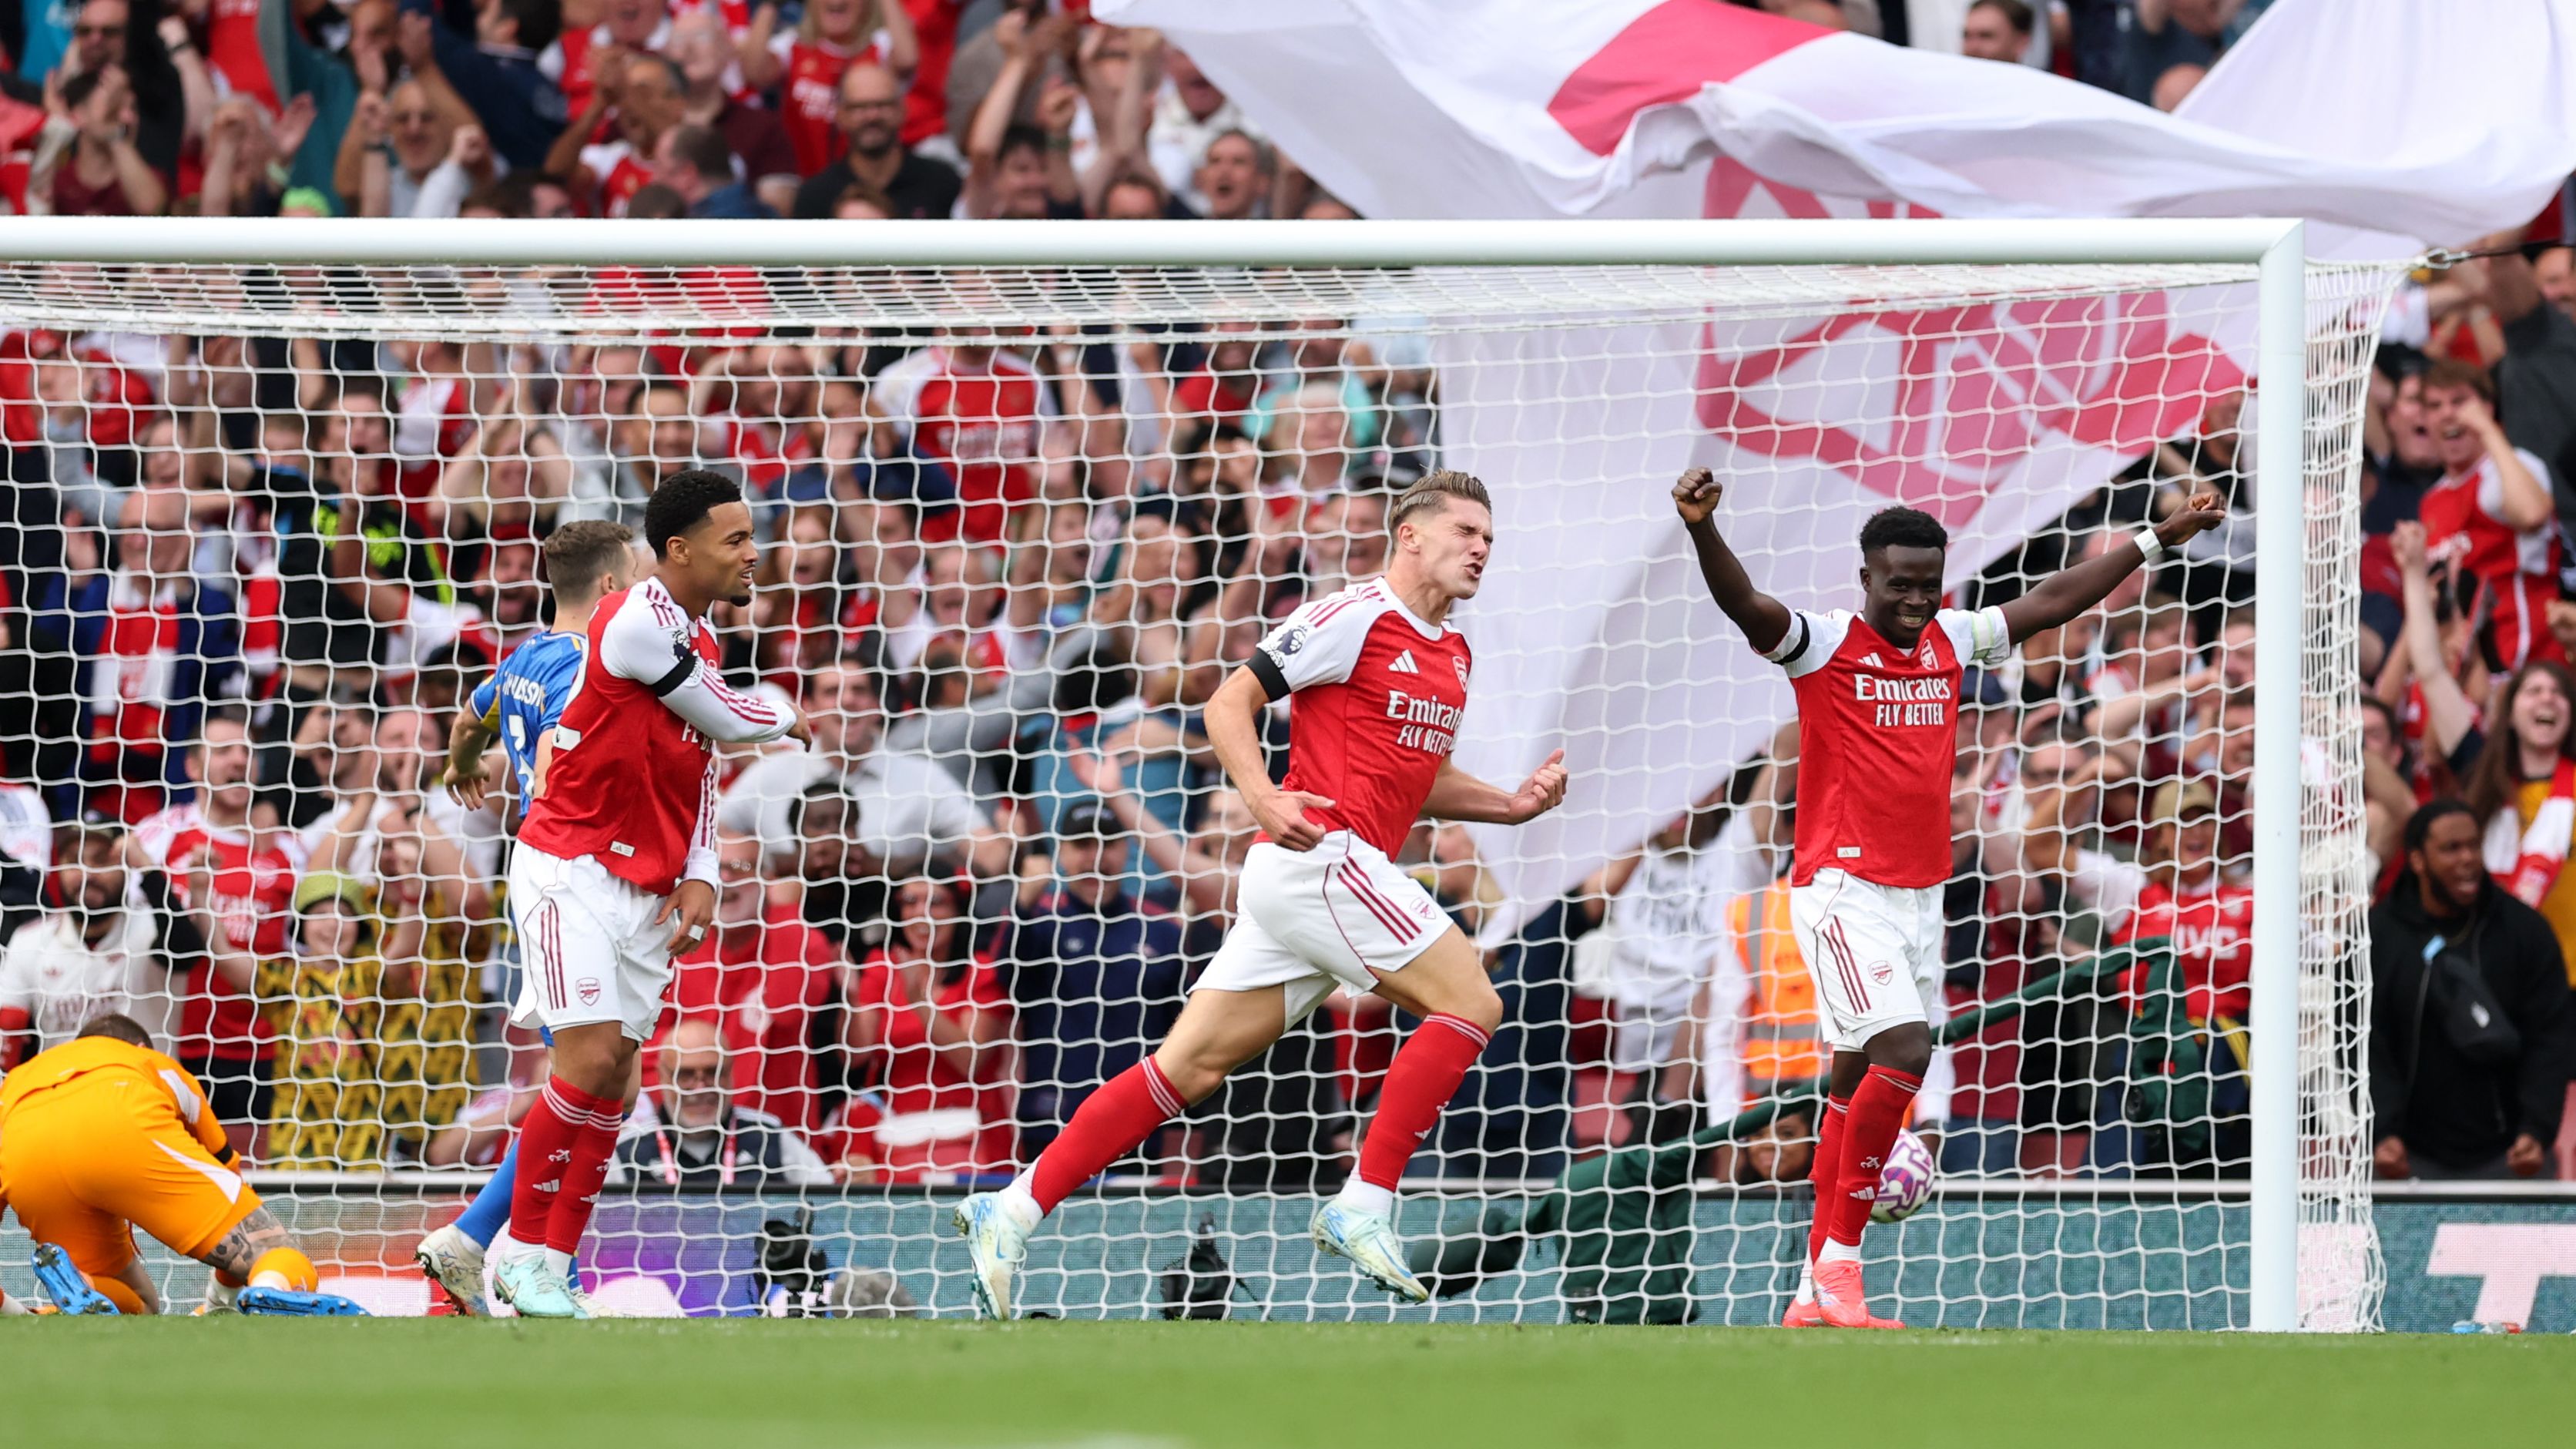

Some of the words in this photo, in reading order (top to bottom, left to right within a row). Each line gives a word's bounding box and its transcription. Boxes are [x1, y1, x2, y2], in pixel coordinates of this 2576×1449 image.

[1853, 673, 1951, 702] Emirates
[1875, 703, 1901, 727] FLY
[1904, 703, 1944, 726] BETTER
[1397, 724, 1424, 749] FLY
